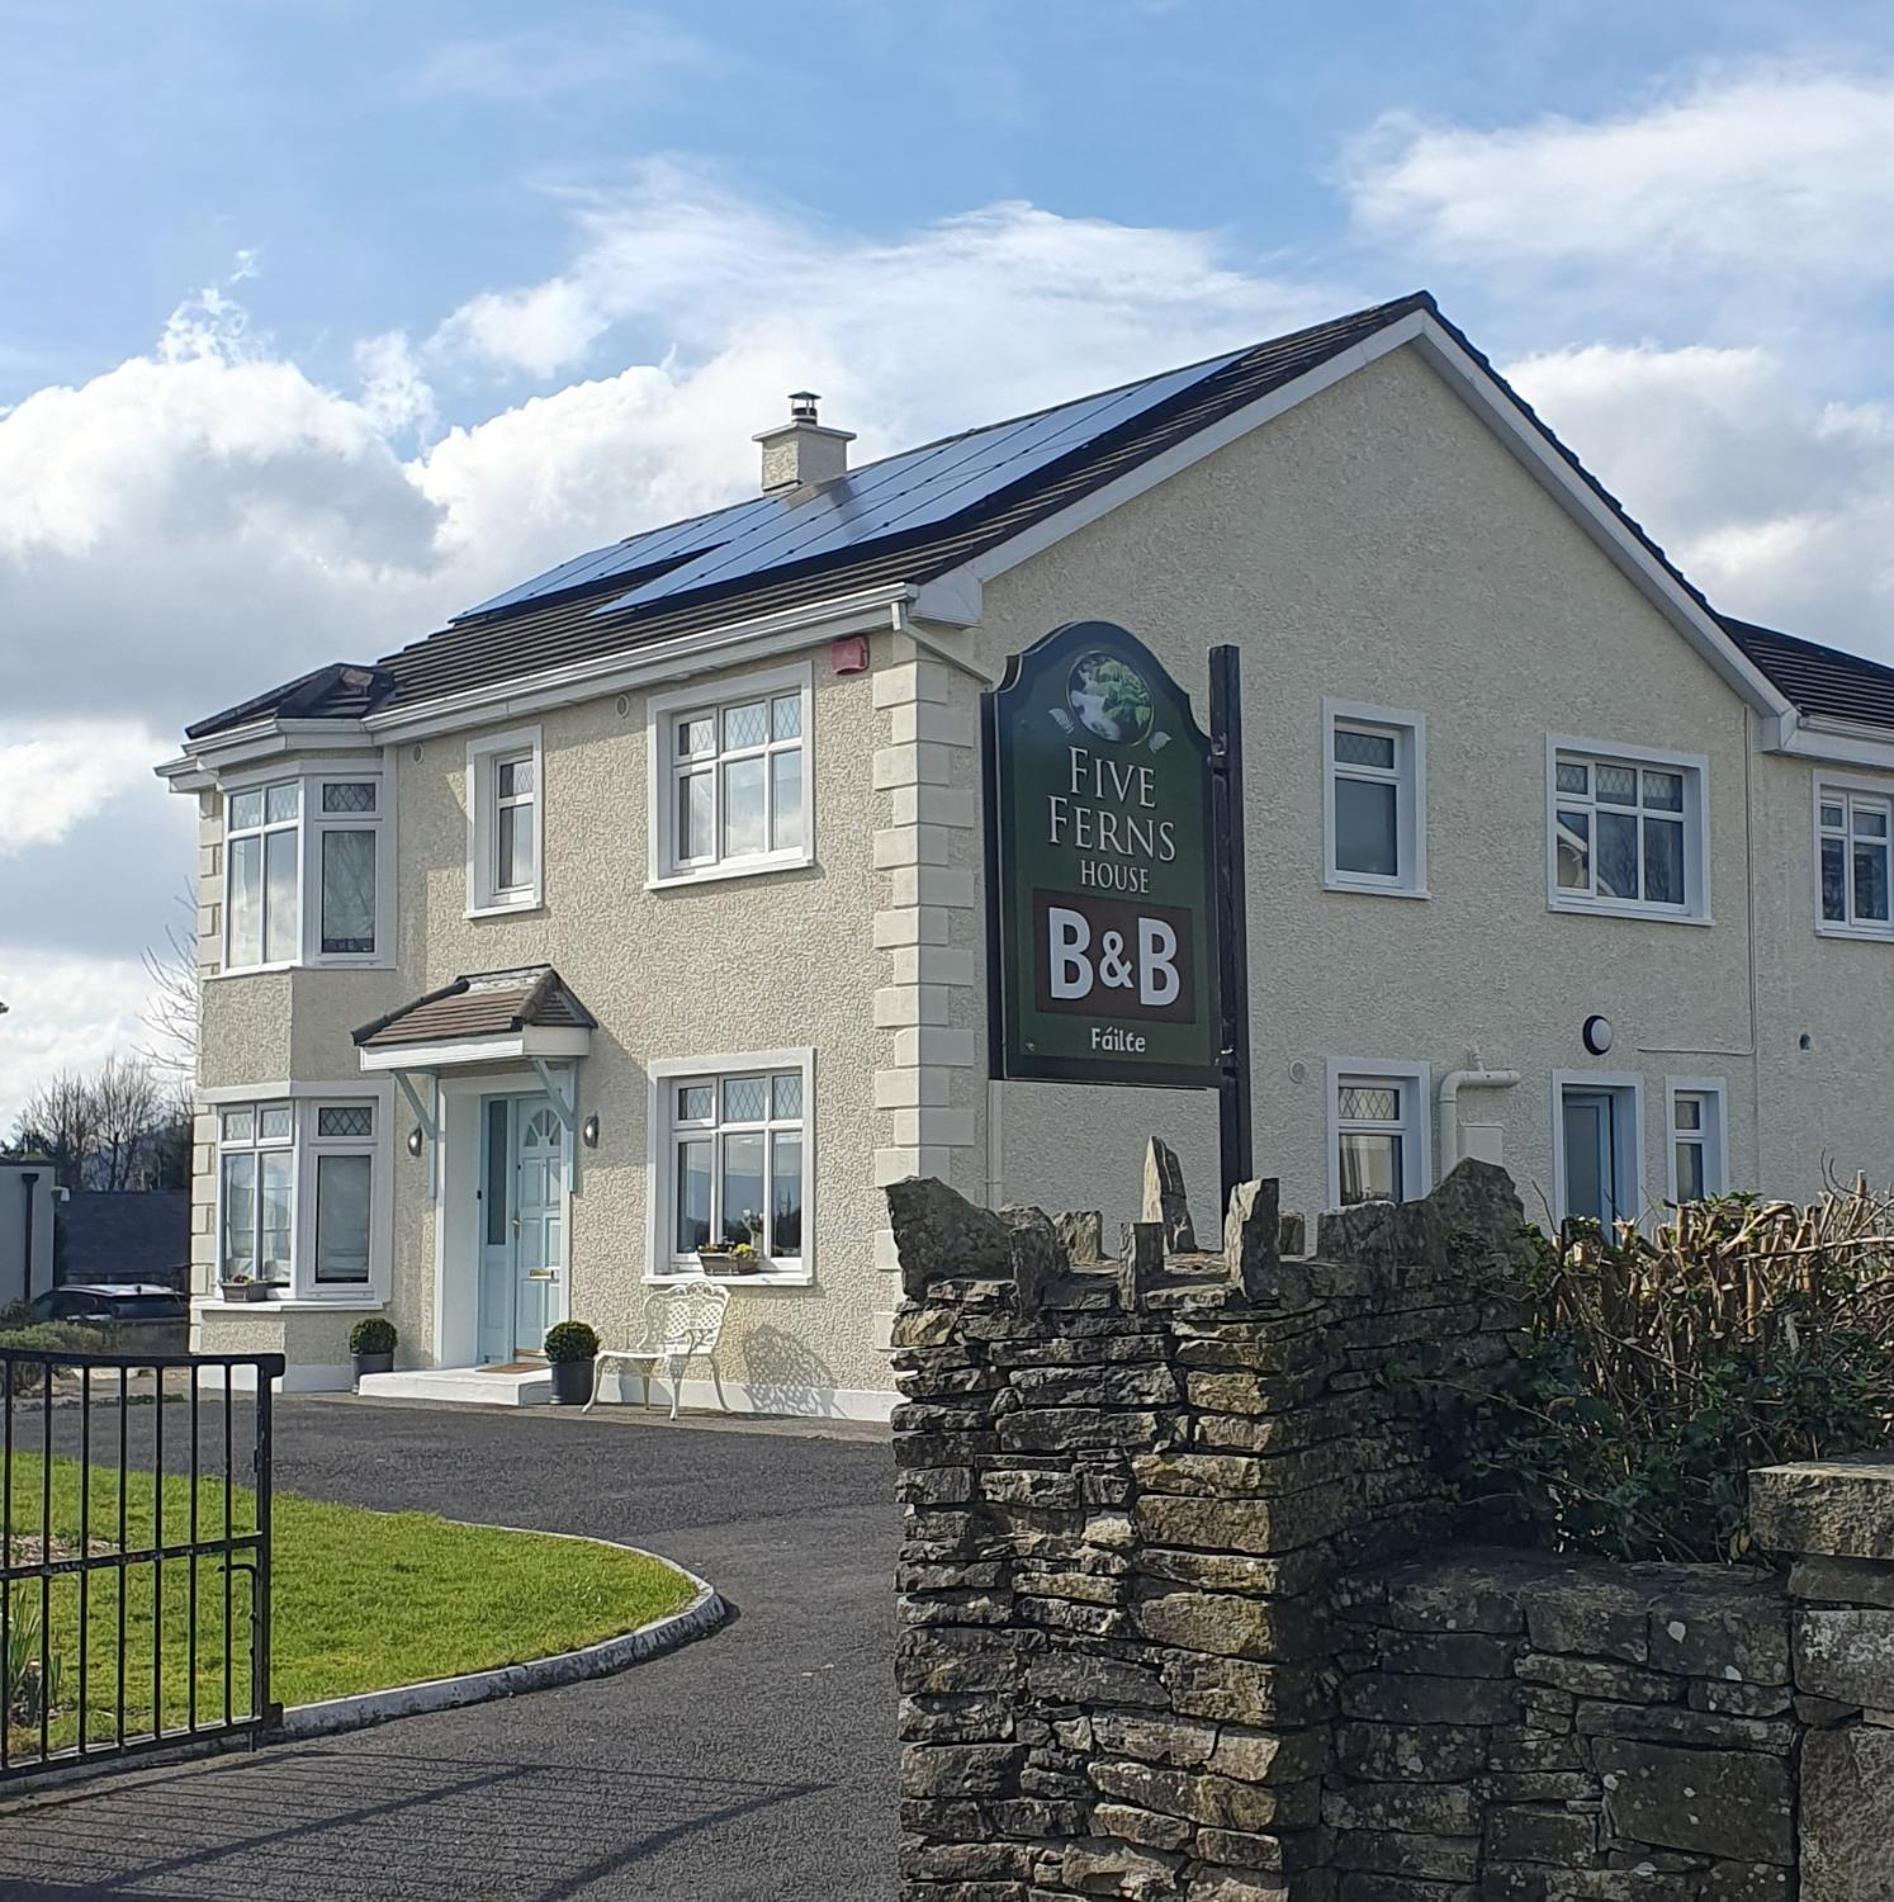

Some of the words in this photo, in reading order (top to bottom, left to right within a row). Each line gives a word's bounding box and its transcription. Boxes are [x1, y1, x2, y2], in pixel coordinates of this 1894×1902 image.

[1068, 746, 1156, 808] FIVE
[1048, 795, 1176, 863] FERNS
[1081, 860, 1150, 894] HOUSE
[1049, 907, 1180, 1006] B&B
[1091, 1026, 1146, 1053] Fáilte
